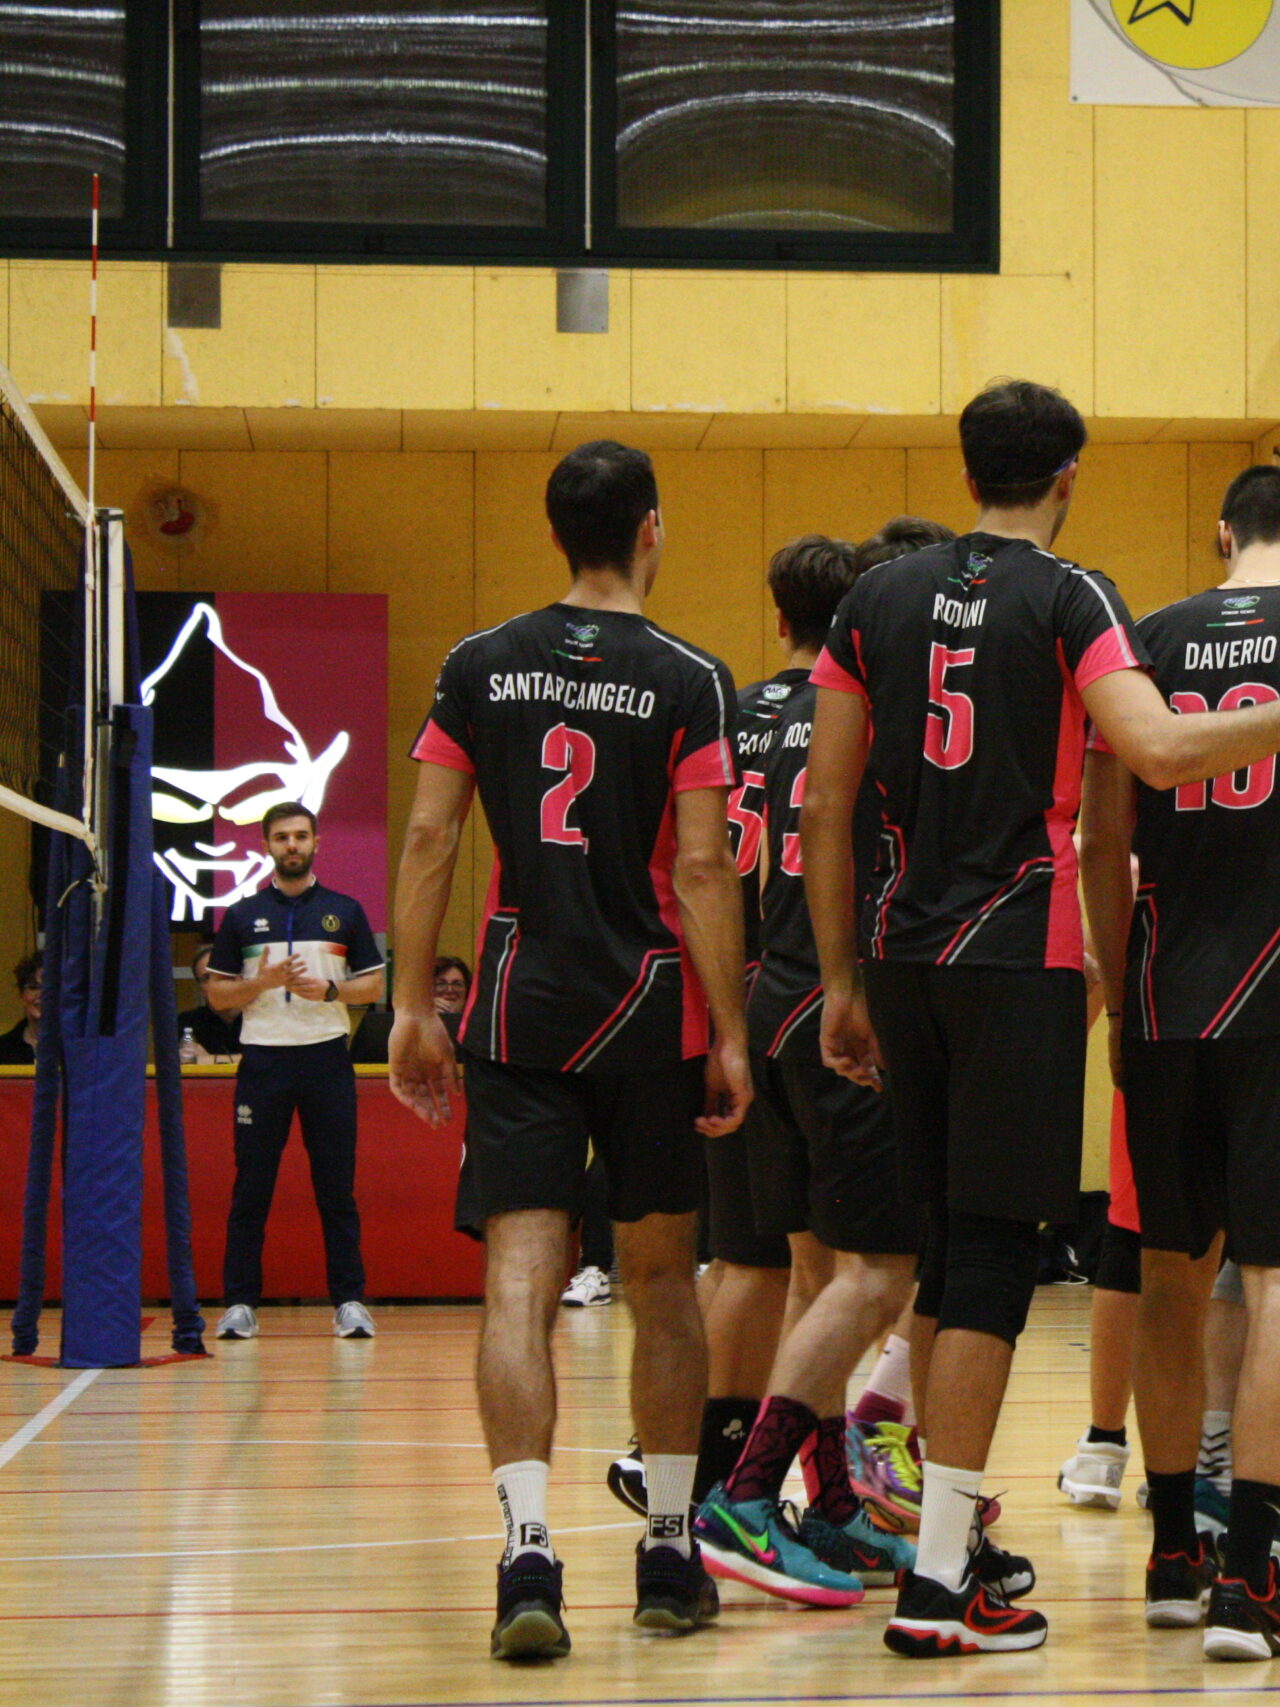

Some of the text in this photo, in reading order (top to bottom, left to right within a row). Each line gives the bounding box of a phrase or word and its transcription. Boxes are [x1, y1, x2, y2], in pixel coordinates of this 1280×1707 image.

[1184, 635, 1278, 671] DAVERIO
[489, 672, 656, 719] SANTARCANGELO
[923, 641, 975, 770] 5
[540, 722, 596, 855] 2
[524, 1524, 550, 1548] FS
[650, 1515, 682, 1537] FS
